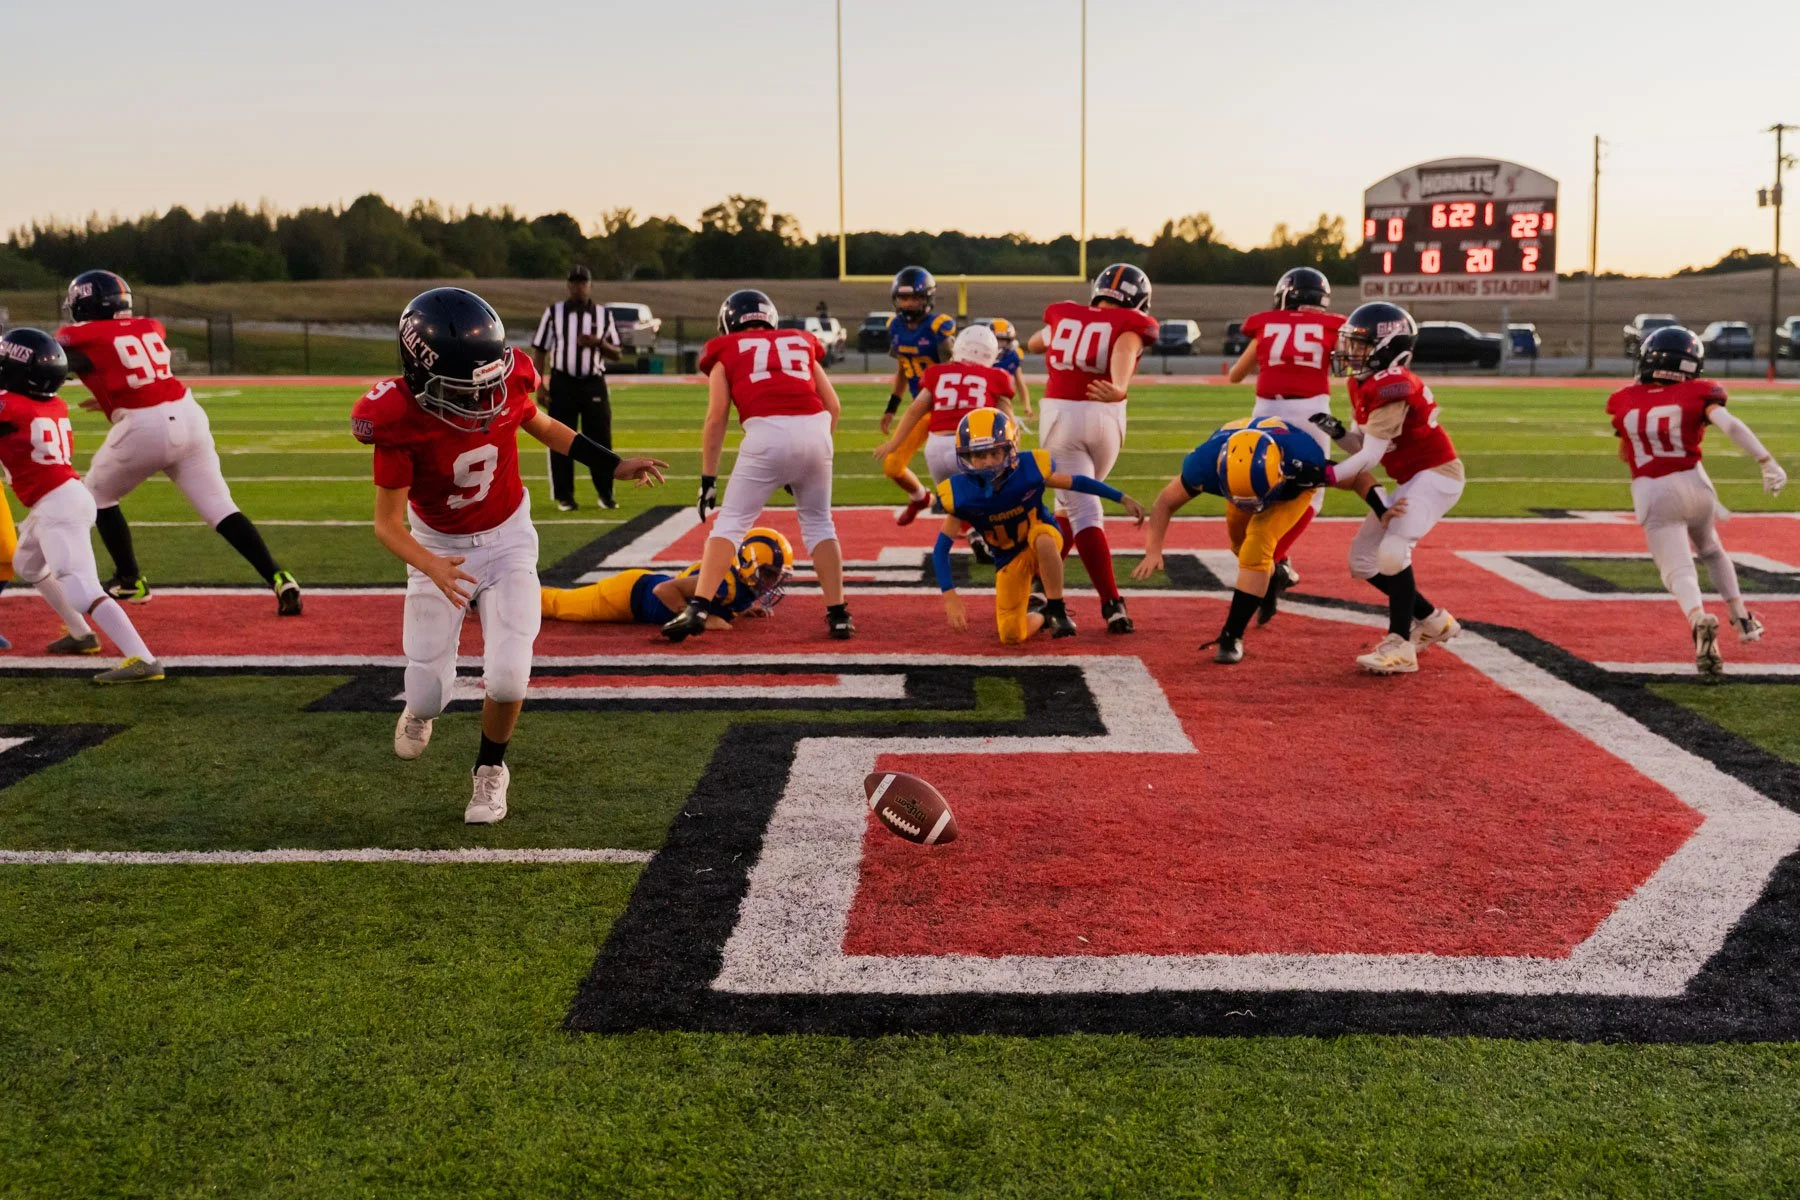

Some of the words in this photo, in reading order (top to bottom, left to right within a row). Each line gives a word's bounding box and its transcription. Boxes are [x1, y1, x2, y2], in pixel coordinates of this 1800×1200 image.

[1388, 218, 1403, 242] 0
[1511, 213, 1540, 238] 22
[1383, 251, 1392, 274] 1
[1466, 248, 1493, 272] 20
[1522, 247, 1538, 271] 2
[1482, 280, 1549, 295] STADIUM
[113, 332, 173, 389] 99
[738, 335, 811, 383] 76
[1050, 318, 1112, 374] 90
[1264, 323, 1324, 369] 75
[934, 373, 987, 411] 53
[1623, 404, 1686, 468] 10
[447, 443, 498, 509] 9
[895, 796, 927, 823] Wilson
